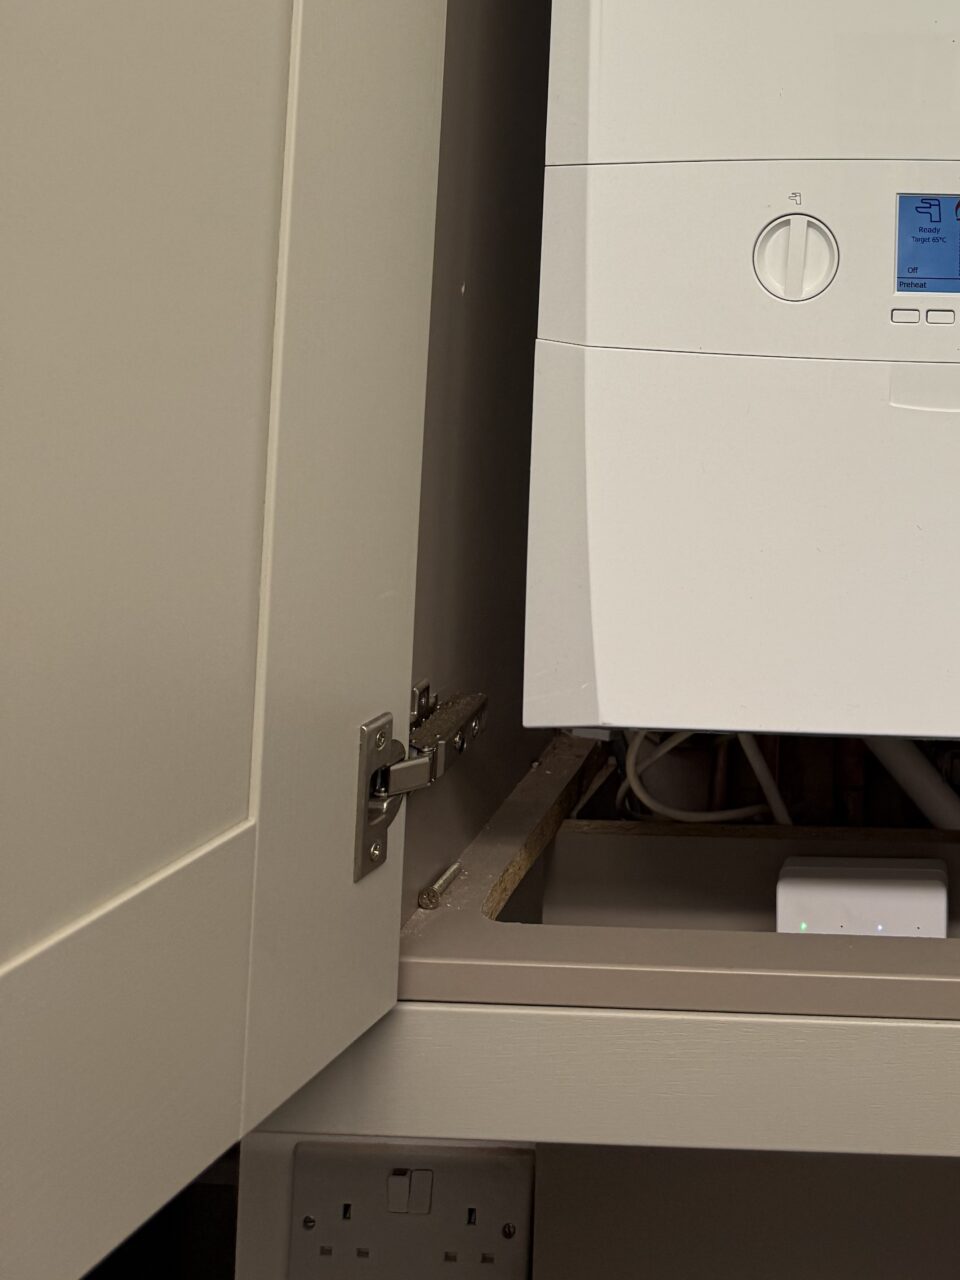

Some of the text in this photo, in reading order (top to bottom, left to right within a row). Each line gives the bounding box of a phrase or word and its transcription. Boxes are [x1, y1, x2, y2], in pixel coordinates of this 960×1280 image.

[918, 226, 941, 234] Ready
[912, 236, 930, 244] Target
[907, 266, 918, 274] Off
